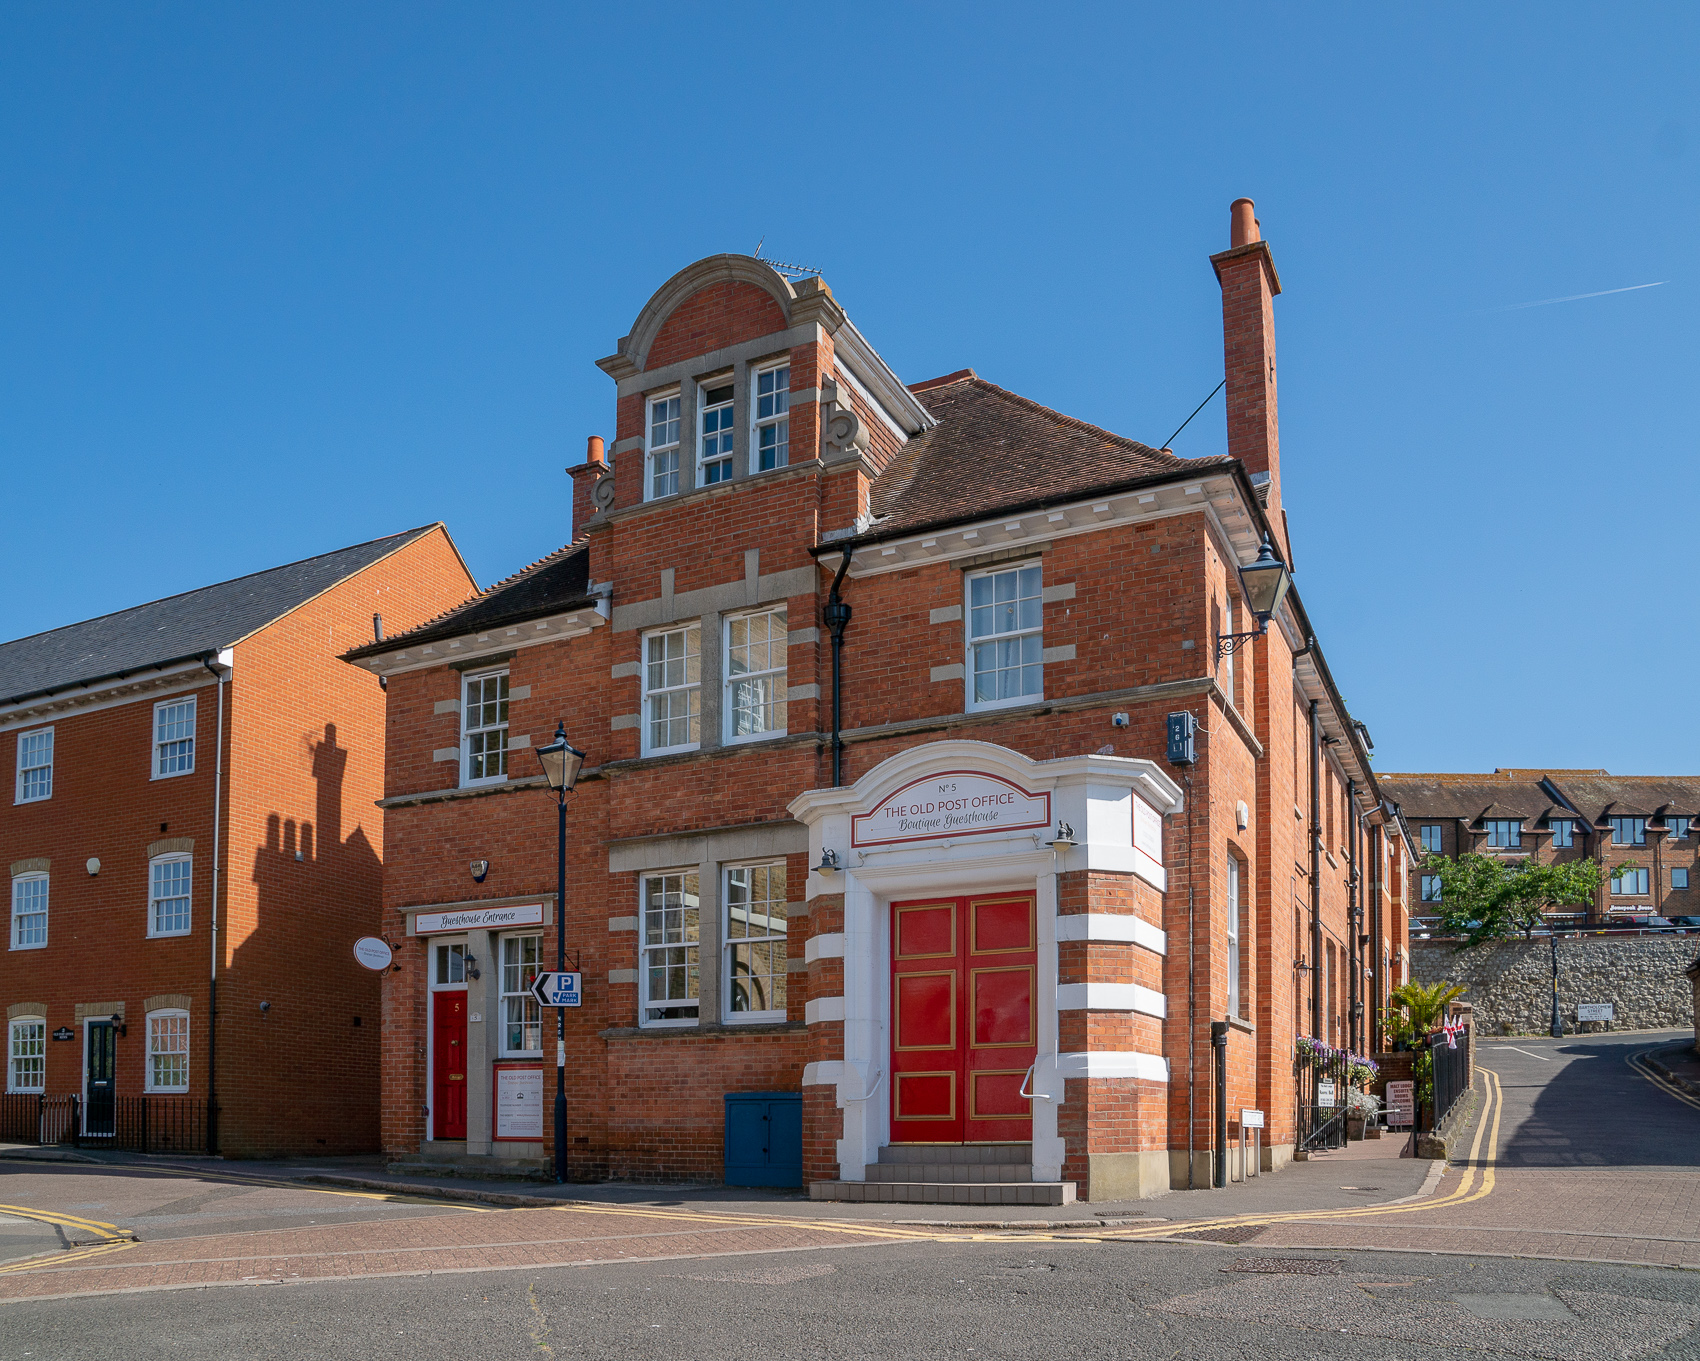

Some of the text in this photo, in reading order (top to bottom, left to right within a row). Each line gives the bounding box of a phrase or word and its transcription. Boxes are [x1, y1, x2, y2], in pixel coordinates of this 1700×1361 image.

[951, 784, 957, 792] 5
[884, 792, 1014, 818] THE OLD POST OFFICE
[898, 810, 999, 832] Boutique Guesthouse
[440, 911, 516, 929] Guesthouse Entrance
[561, 977, 571, 989] P
[454, 1003, 459, 1012] 5
